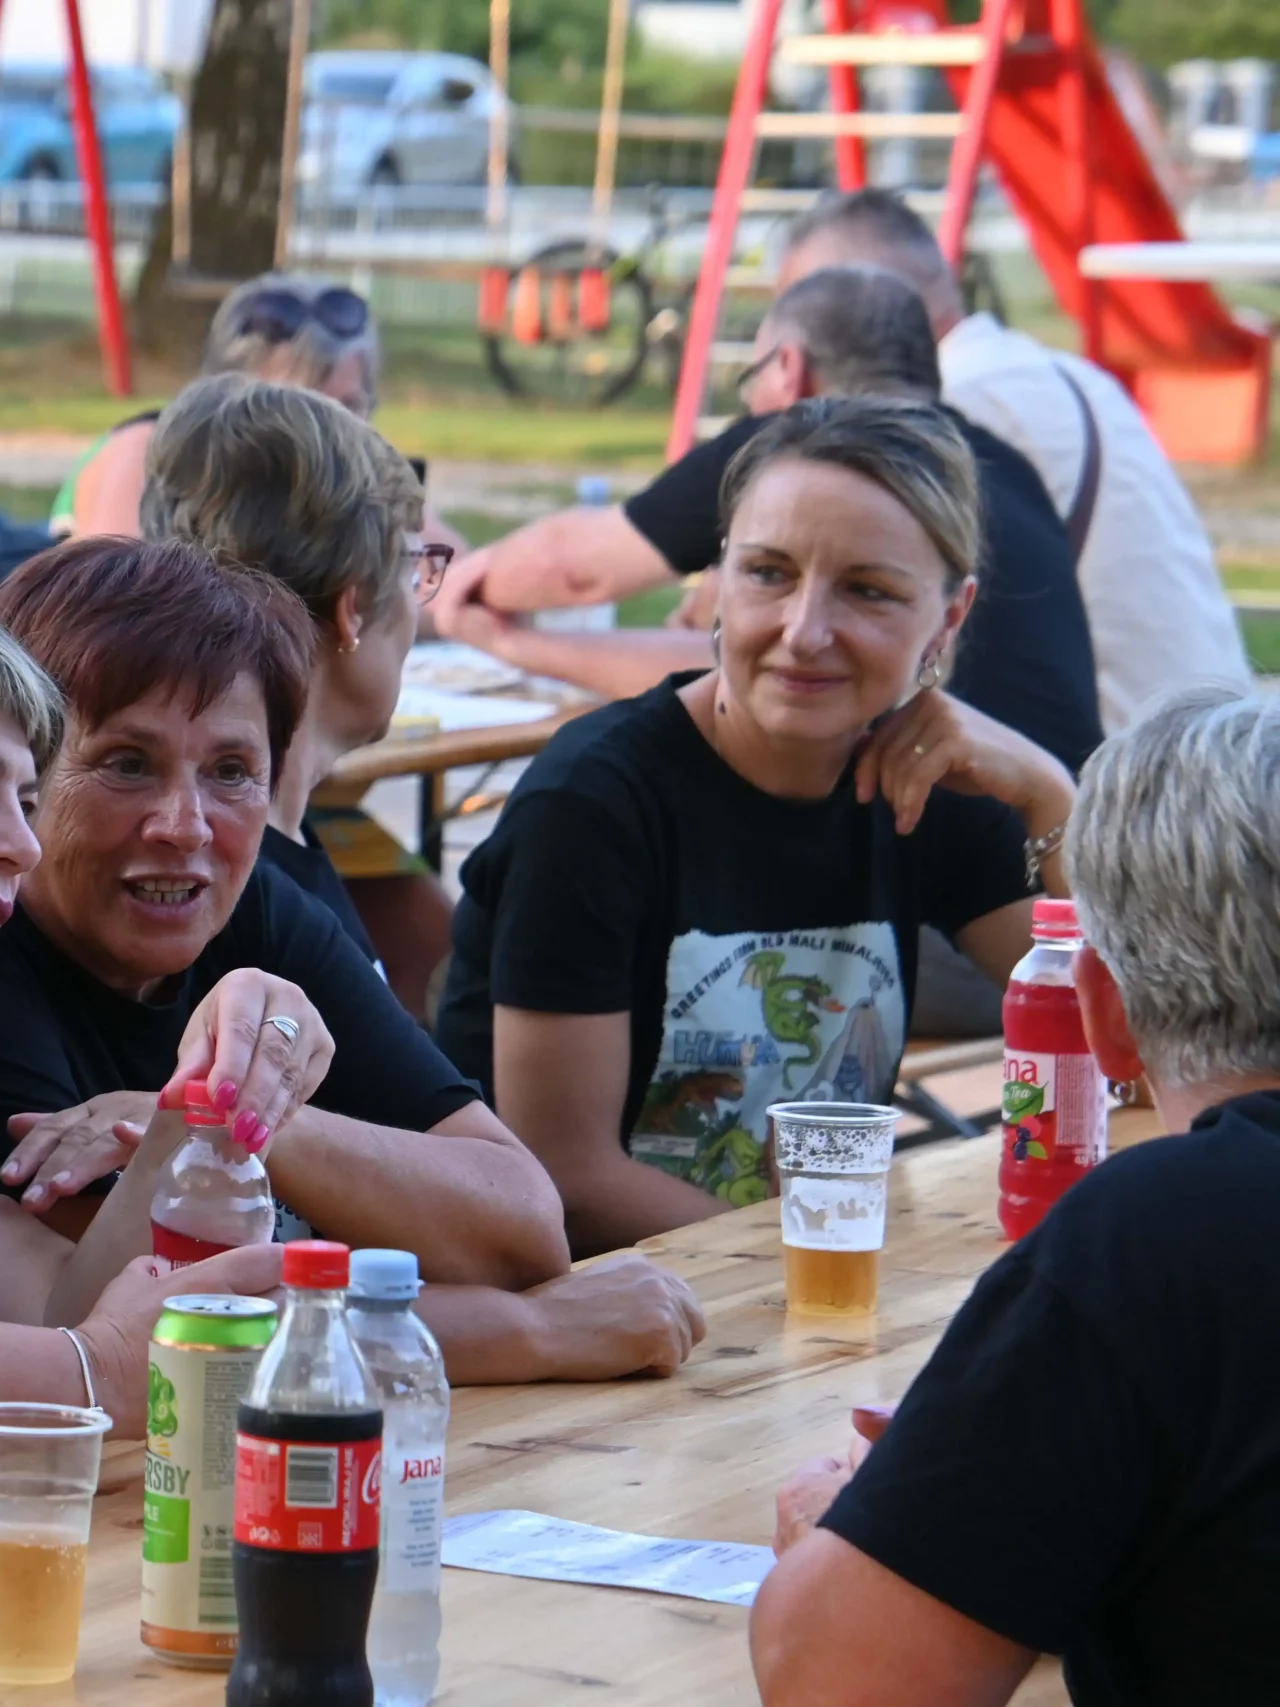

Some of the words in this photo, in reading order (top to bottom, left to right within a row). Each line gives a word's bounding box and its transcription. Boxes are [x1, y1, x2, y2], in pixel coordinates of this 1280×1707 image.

[671, 957, 732, 1019] GREETINGS
[788, 934, 825, 951] MALI
[1003, 1058, 1039, 1085] na
[147, 1456, 191, 1496] RSBY
